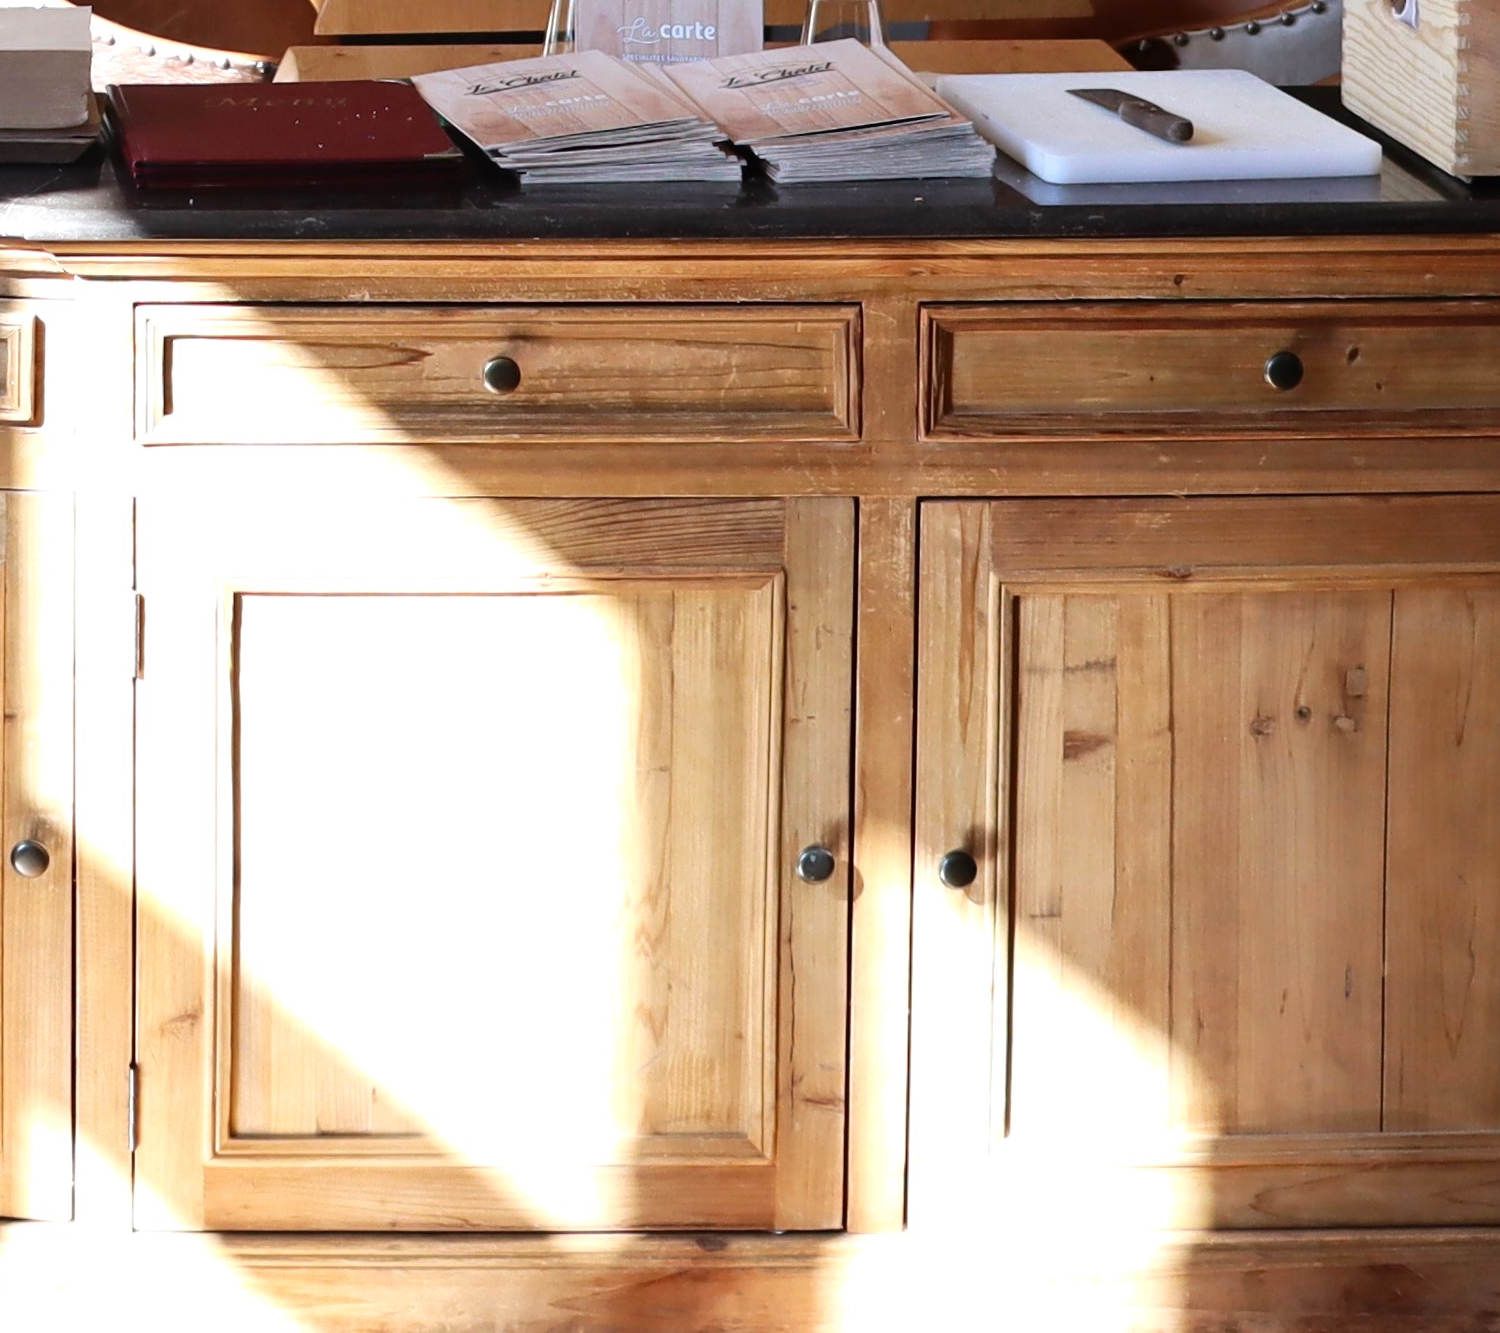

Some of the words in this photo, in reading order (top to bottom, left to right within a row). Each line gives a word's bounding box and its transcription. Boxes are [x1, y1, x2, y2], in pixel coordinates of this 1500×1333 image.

[616, 17, 660, 44] La
[659, 21, 716, 41] carte
[545, 94, 608, 106] carte
[798, 90, 860, 104] carte
